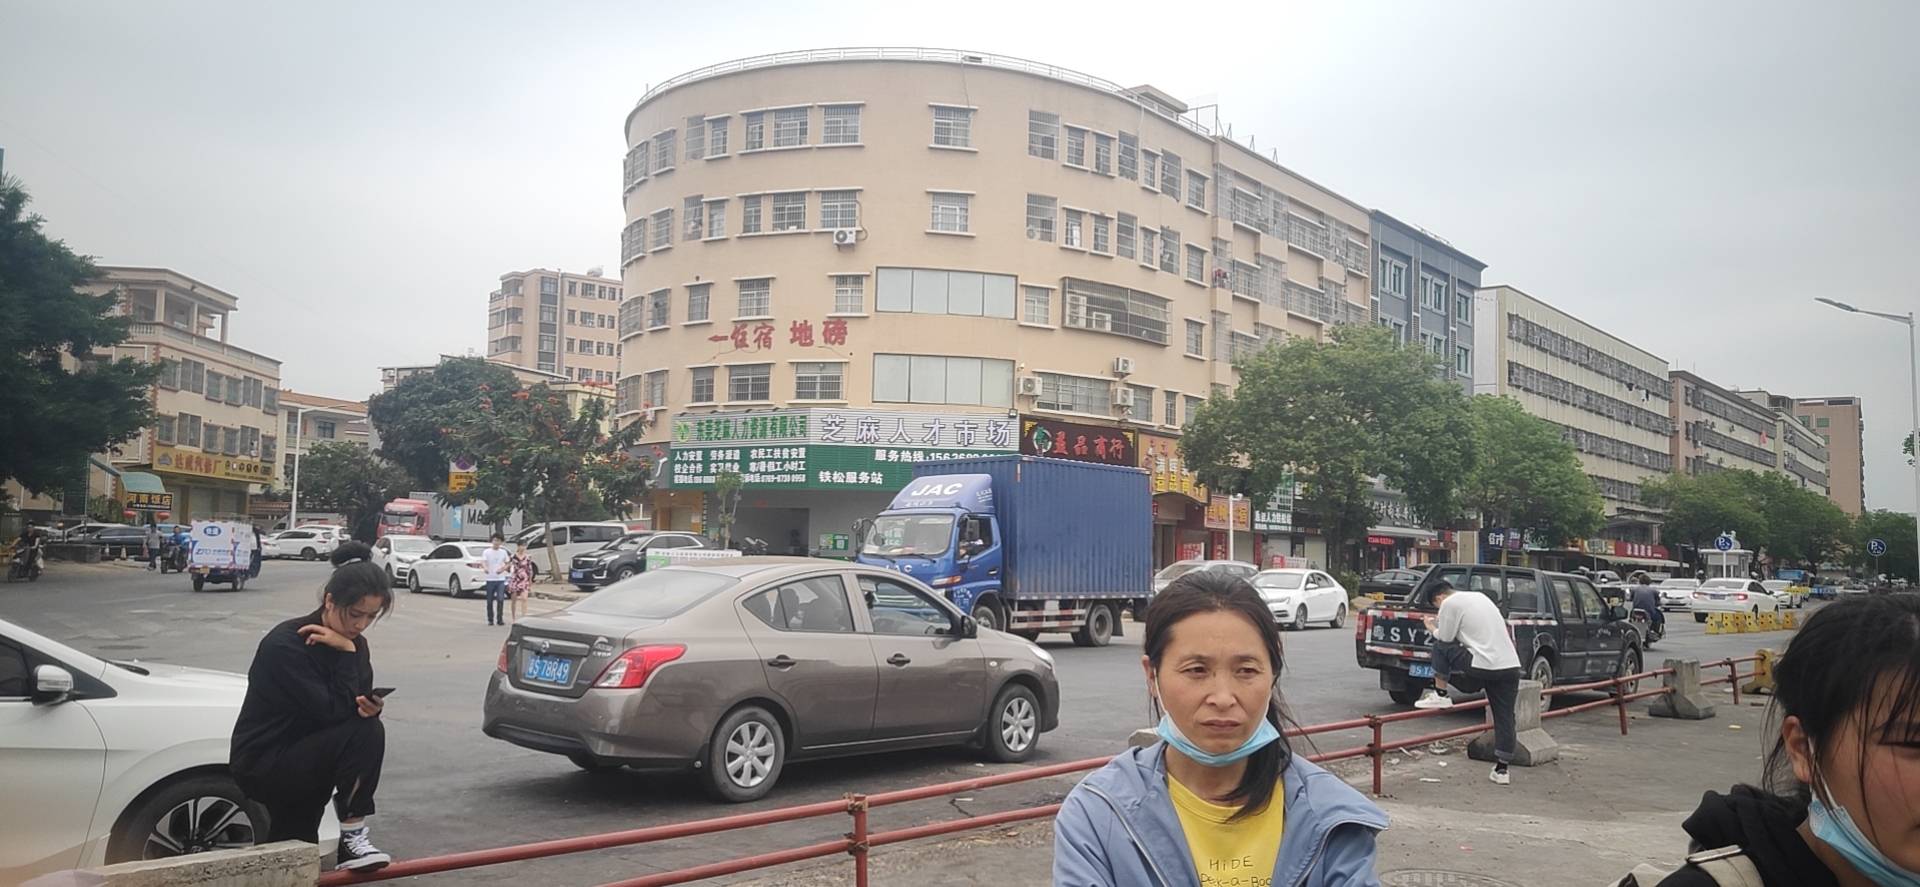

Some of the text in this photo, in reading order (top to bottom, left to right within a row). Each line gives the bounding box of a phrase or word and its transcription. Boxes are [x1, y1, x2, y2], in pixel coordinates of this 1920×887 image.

[790, 320, 848, 347] 地磅
[696, 416, 807, 441] 东莞芝麻人力资源有限公司
[821, 415, 1011, 447] 芝麻人才市场
[674, 451, 703, 461] 人力安置
[674, 463, 703, 474] 校企合作
[818, 471, 884, 484] 铁松服务站
[911, 483, 963, 496] JAC
